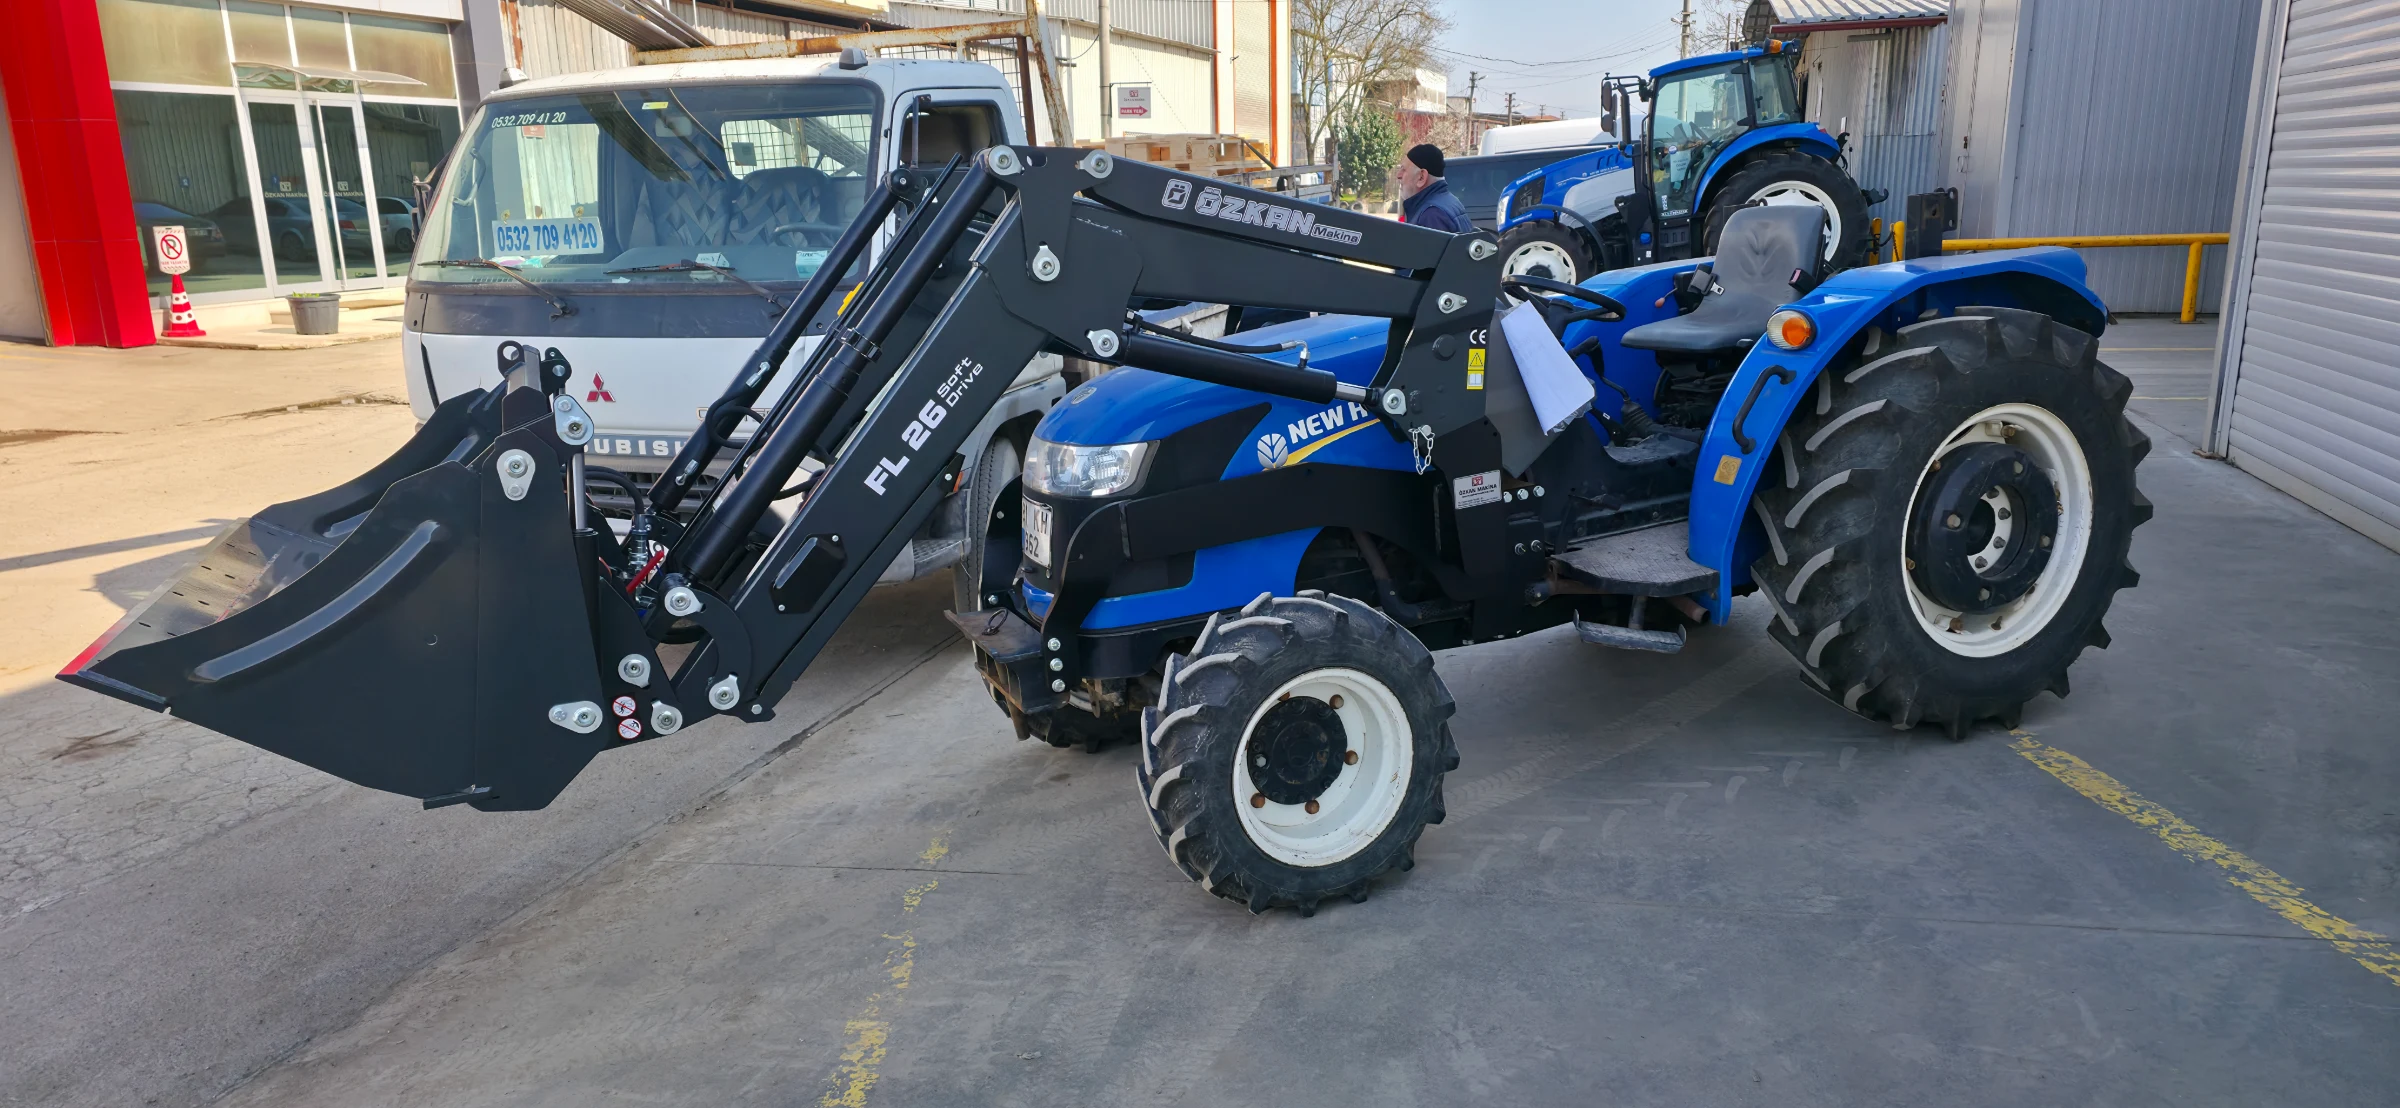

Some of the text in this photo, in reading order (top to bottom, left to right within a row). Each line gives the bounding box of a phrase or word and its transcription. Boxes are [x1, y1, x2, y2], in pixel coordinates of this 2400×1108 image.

[537, 112, 551, 124] 41
[552, 111, 567, 123] 20
[1195, 186, 1315, 235] ÖZKAN
[1313, 226, 1360, 244] Makina
[497, 222, 598, 251] 0532 709 4120
[1469, 329, 1487, 344] CE
[937, 357, 972, 398] Soft
[945, 363, 983, 407] Drive
[1288, 402, 1368, 444] NEW H
[863, 399, 947, 496] FL 26
[1033, 507, 1048, 534] KH
